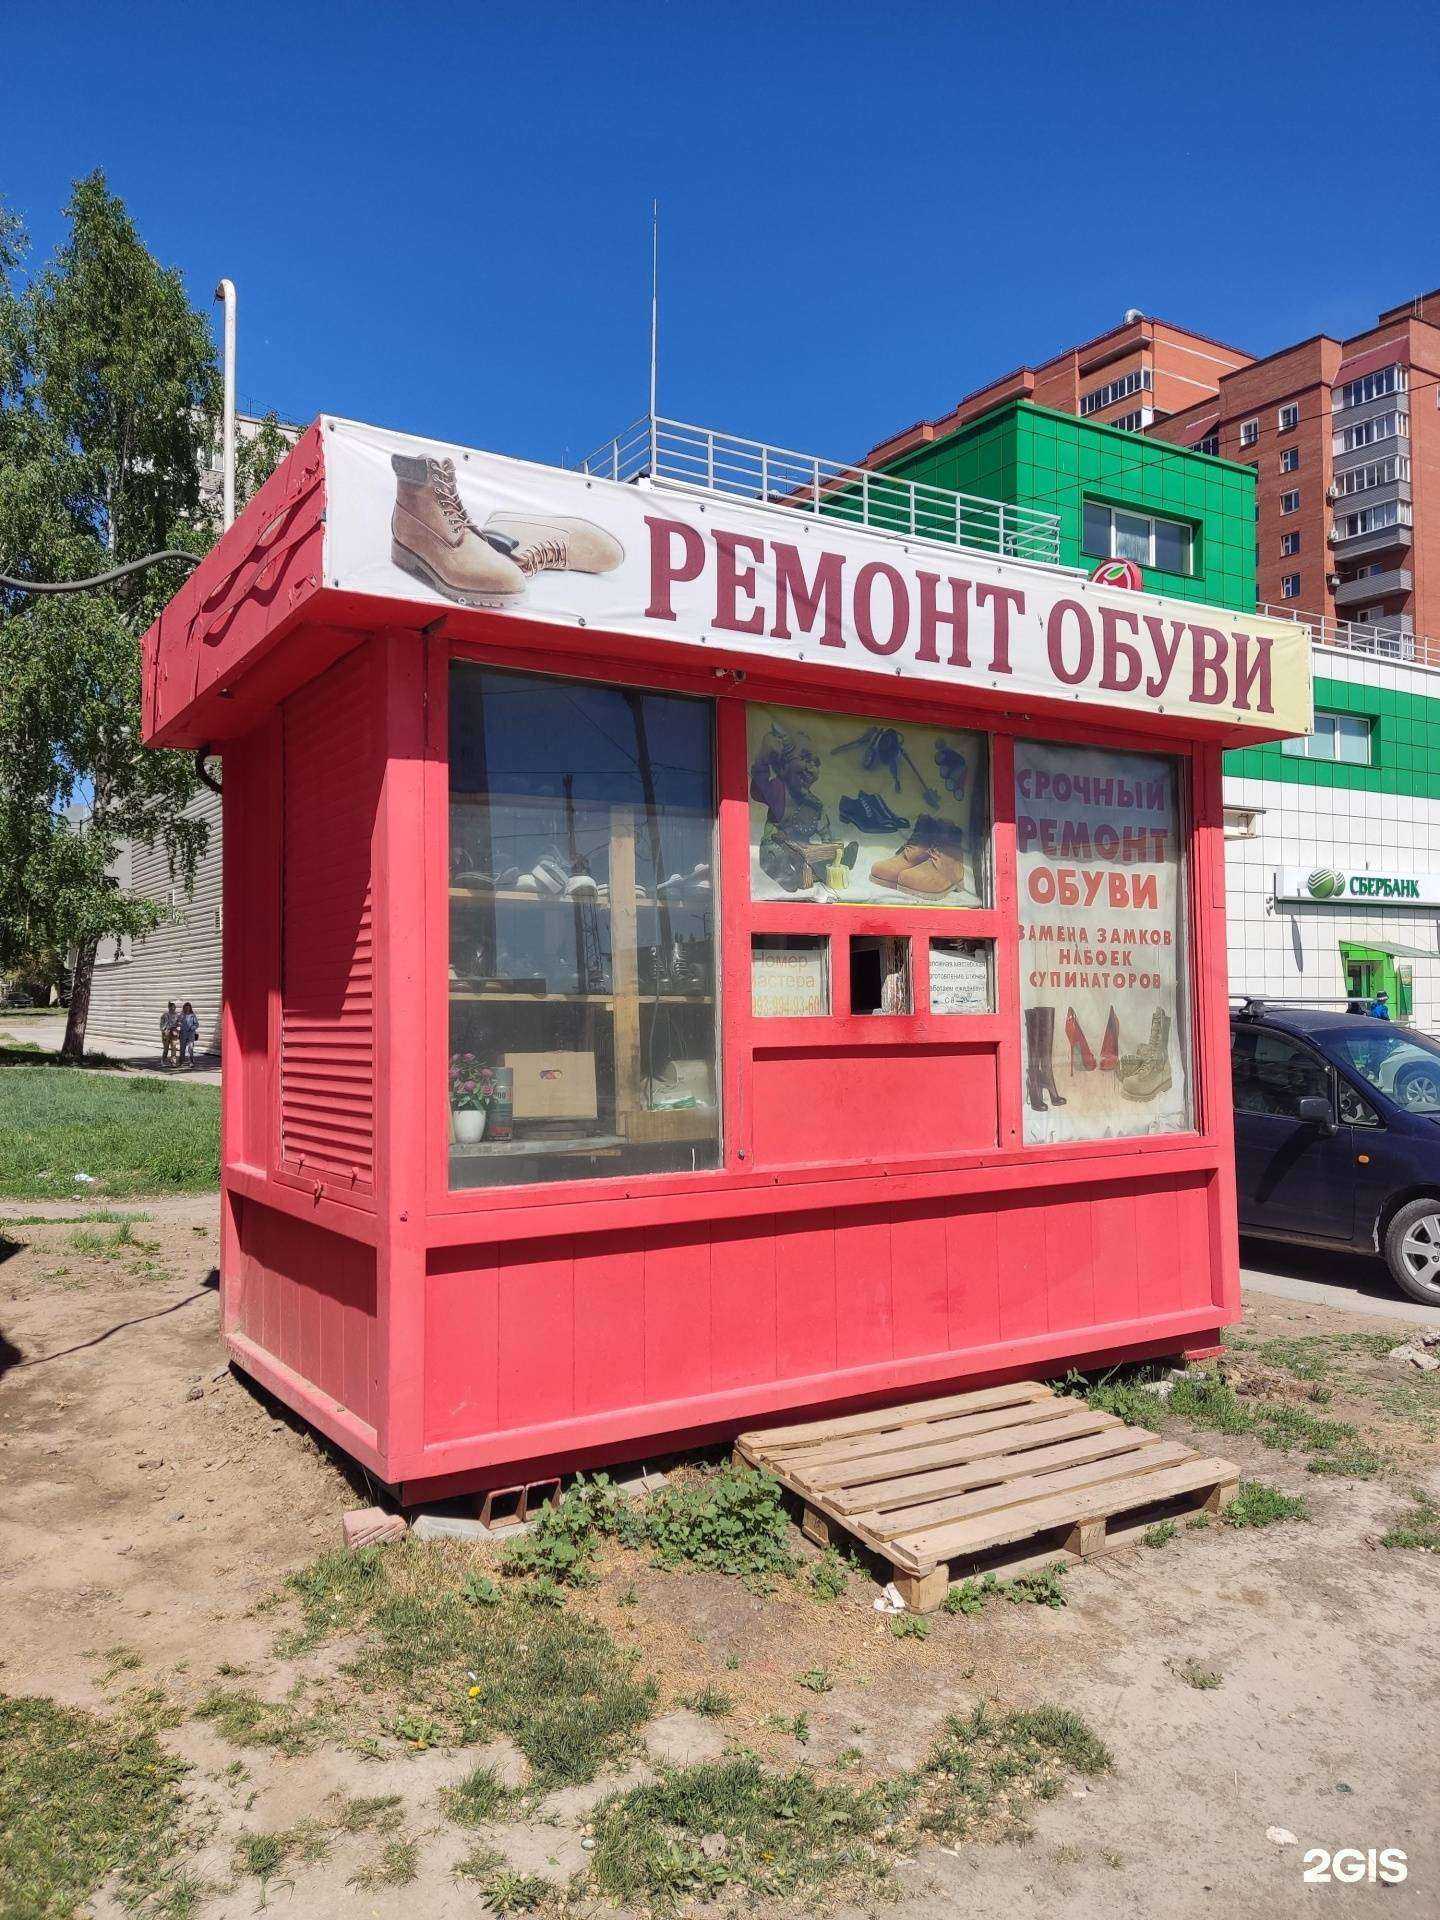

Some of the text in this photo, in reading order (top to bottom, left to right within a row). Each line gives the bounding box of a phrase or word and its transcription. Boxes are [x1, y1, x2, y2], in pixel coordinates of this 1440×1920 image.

[644, 515, 1275, 714] РЕМОНТ ОБУВИ
[1016, 769, 1165, 811] СРОЧНЫЙ
[1017, 815, 1168, 864] РЕМОНТ
[1028, 866, 1158, 909] ОБУВИ
[1349, 876, 1420, 898] СБЕРБАНК
[1018, 924, 1172, 946] ЗАМЕНА ЗАМКОВ
[1058, 947, 1132, 966] НАБОЕК
[753, 975, 816, 991] астера
[1029, 971, 1161, 989] СУПИНАТОРОВ
